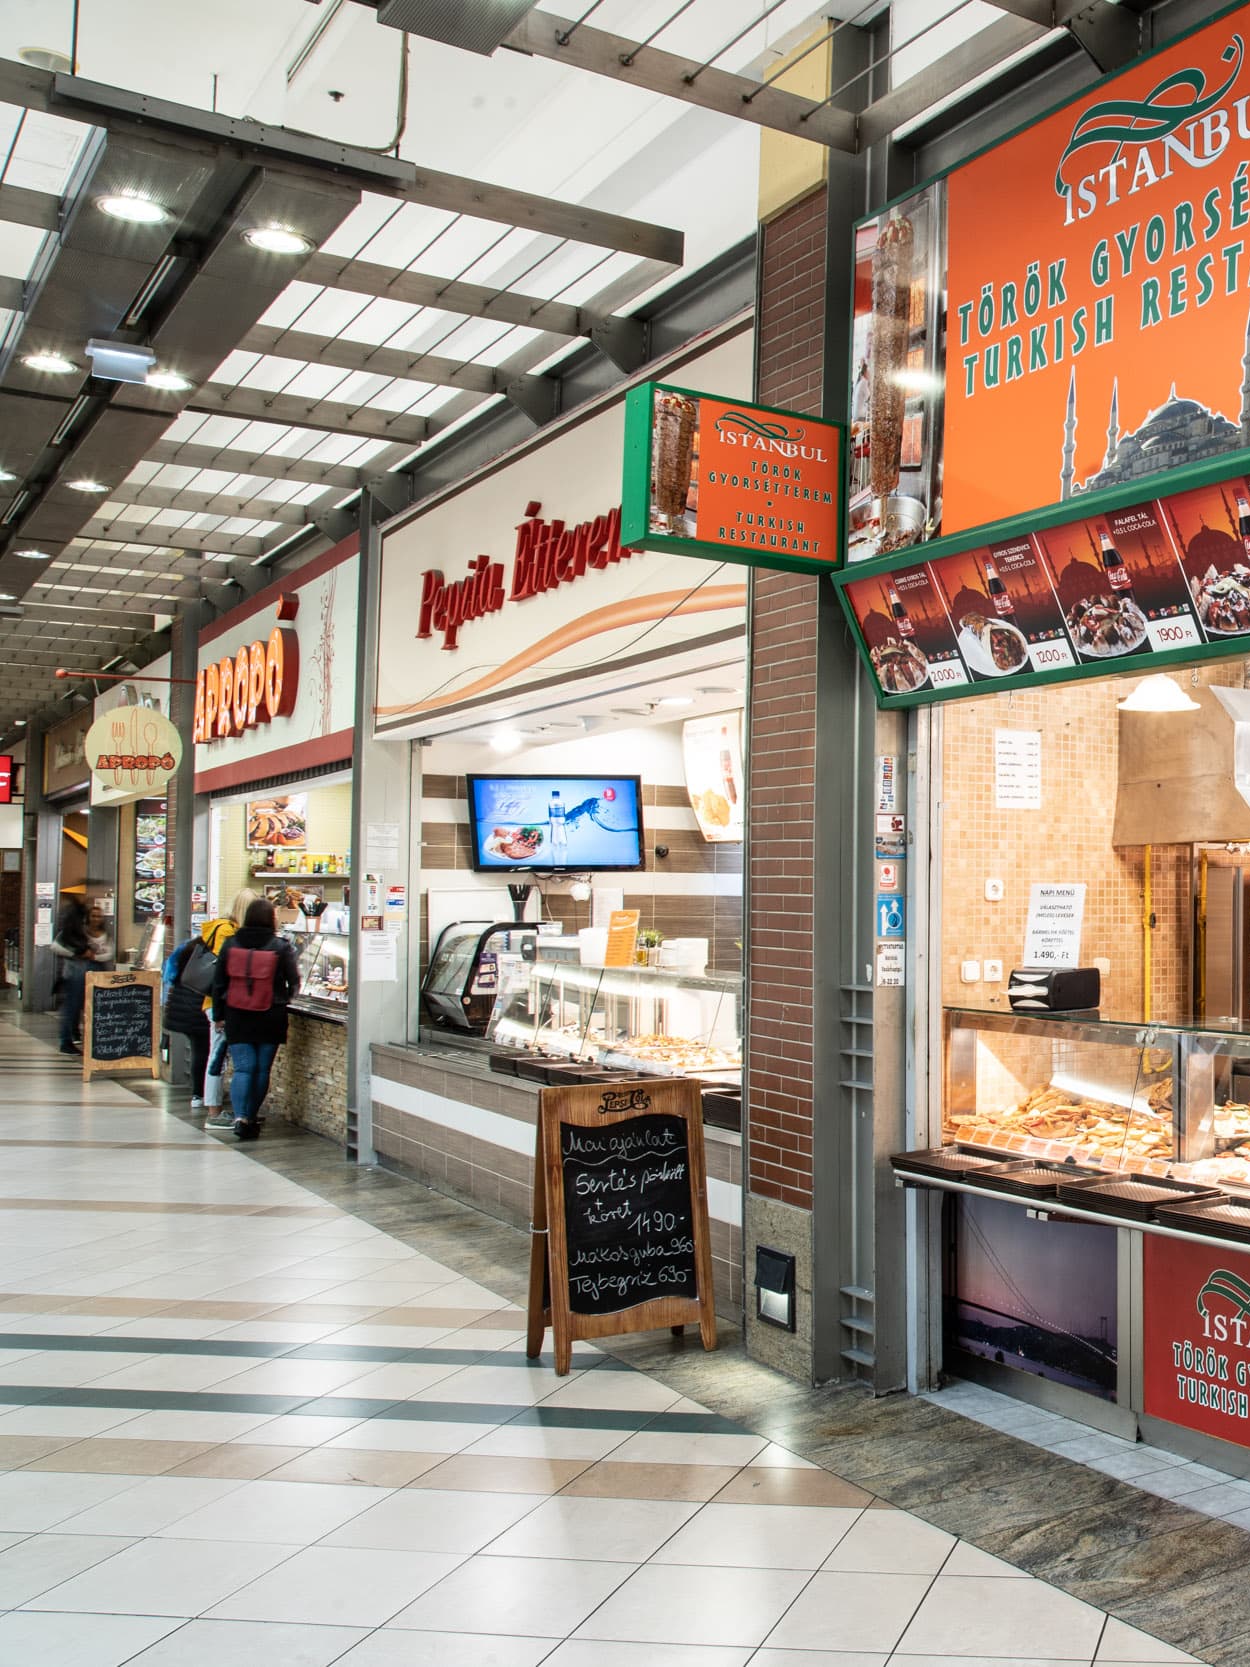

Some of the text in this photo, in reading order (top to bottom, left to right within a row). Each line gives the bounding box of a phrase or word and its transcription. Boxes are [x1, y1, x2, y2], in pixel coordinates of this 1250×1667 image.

[958, 259, 1067, 347] TÖRÖK
[963, 294, 1113, 398] TURKISH
[751, 461, 801, 481] TÖRÖK
[708, 471, 833, 504] GYORSÉTTEREM
[736, 512, 805, 533] TURKISH
[719, 527, 821, 553] RESTAURANT
[415, 555, 505, 650] Pepita
[1157, 626, 1193, 642] 1900 Ft
[1036, 649, 1061, 664] 1200
[931, 668, 955, 683] 2000
[95, 752, 176, 771] APROPÓ
[1056, 888, 1075, 896] MENÜ
[1062, 951, 1069, 959] Ft
[563, 1128, 676, 1159] Mai ajánlat
[575, 1168, 636, 1196] Sertés
[584, 1199, 632, 1225] köret
[1173, 1340, 1229, 1381] TÖRÖK
[1177, 1375, 1249, 1418] TURKISH
